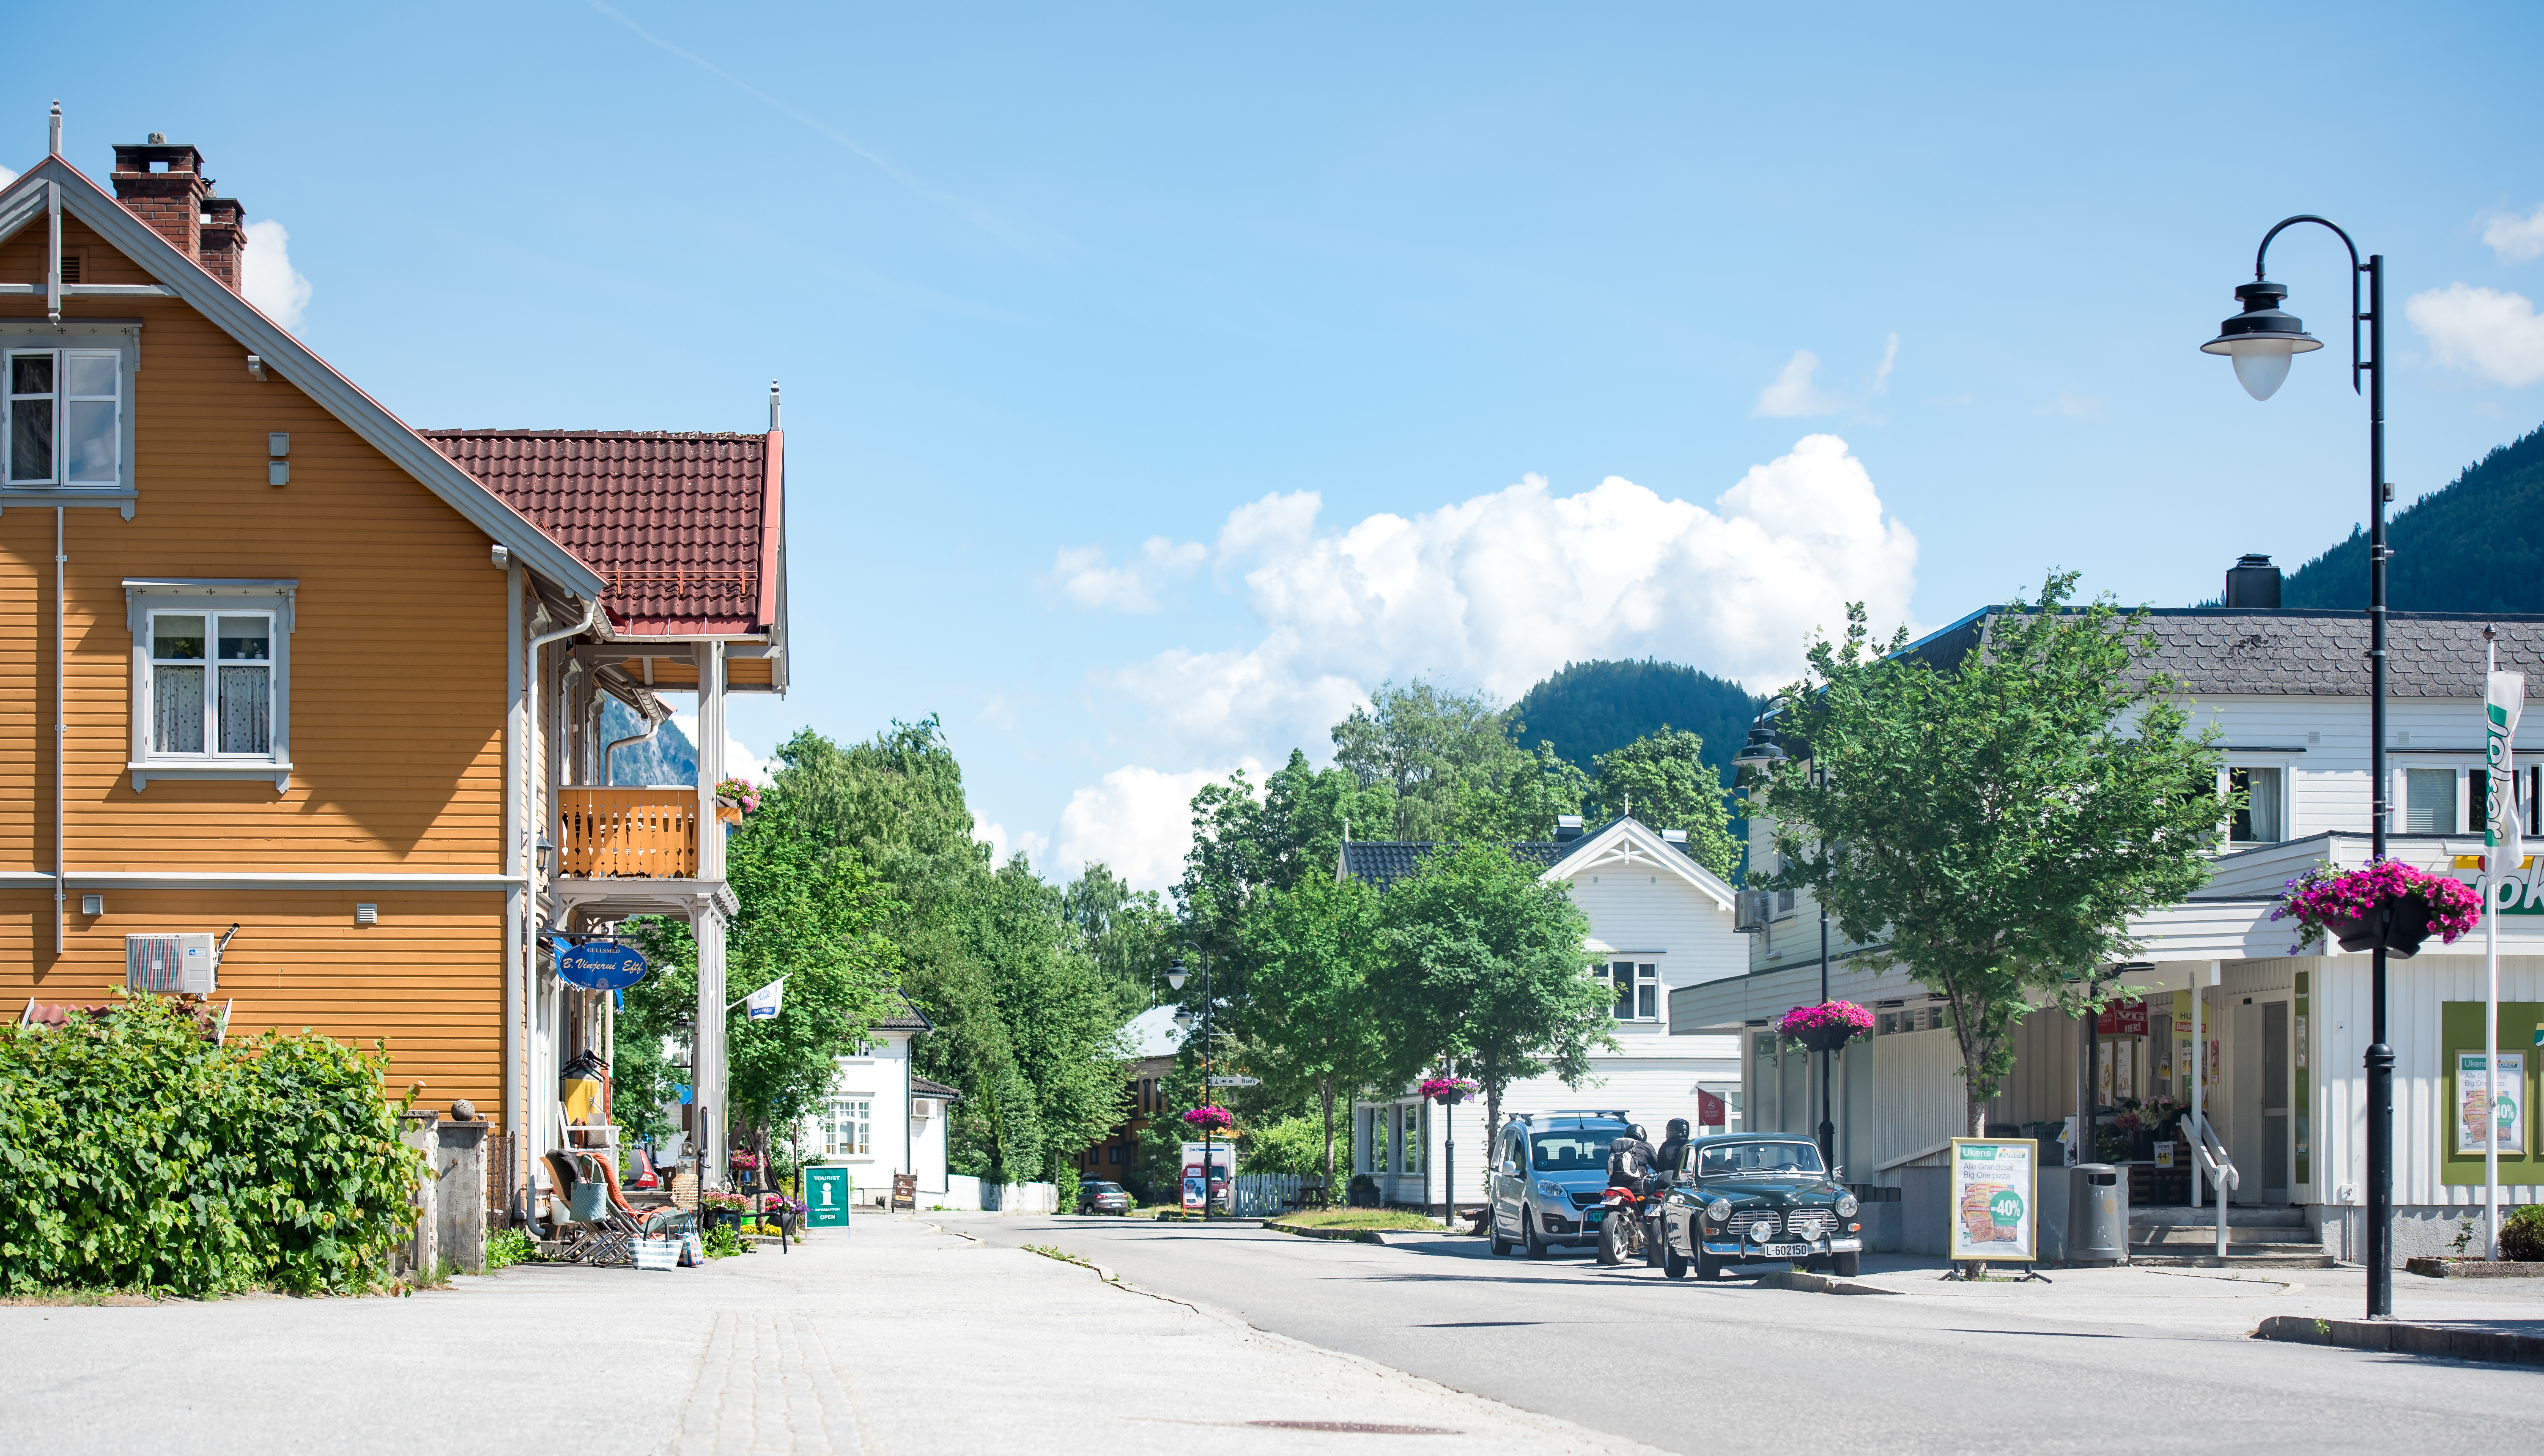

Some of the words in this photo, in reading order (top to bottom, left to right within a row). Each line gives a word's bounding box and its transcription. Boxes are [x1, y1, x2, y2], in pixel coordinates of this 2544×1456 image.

[2474, 856, 2544, 910] jok
[563, 958, 573, 968] B.
[575, 958, 617, 973] Vinjerui
[622, 960, 644, 974] Eftf.
[2117, 1012, 2144, 1020] VG
[2125, 1022, 2141, 1033] HER!
[1963, 1148, 1991, 1157] Ukens
[1999, 1148, 2026, 1159] joker
[1964, 1171, 1974, 1180] Big
[1990, 1199, 2020, 1217] -40%
[1766, 1245, 1807, 1256] L-602150
